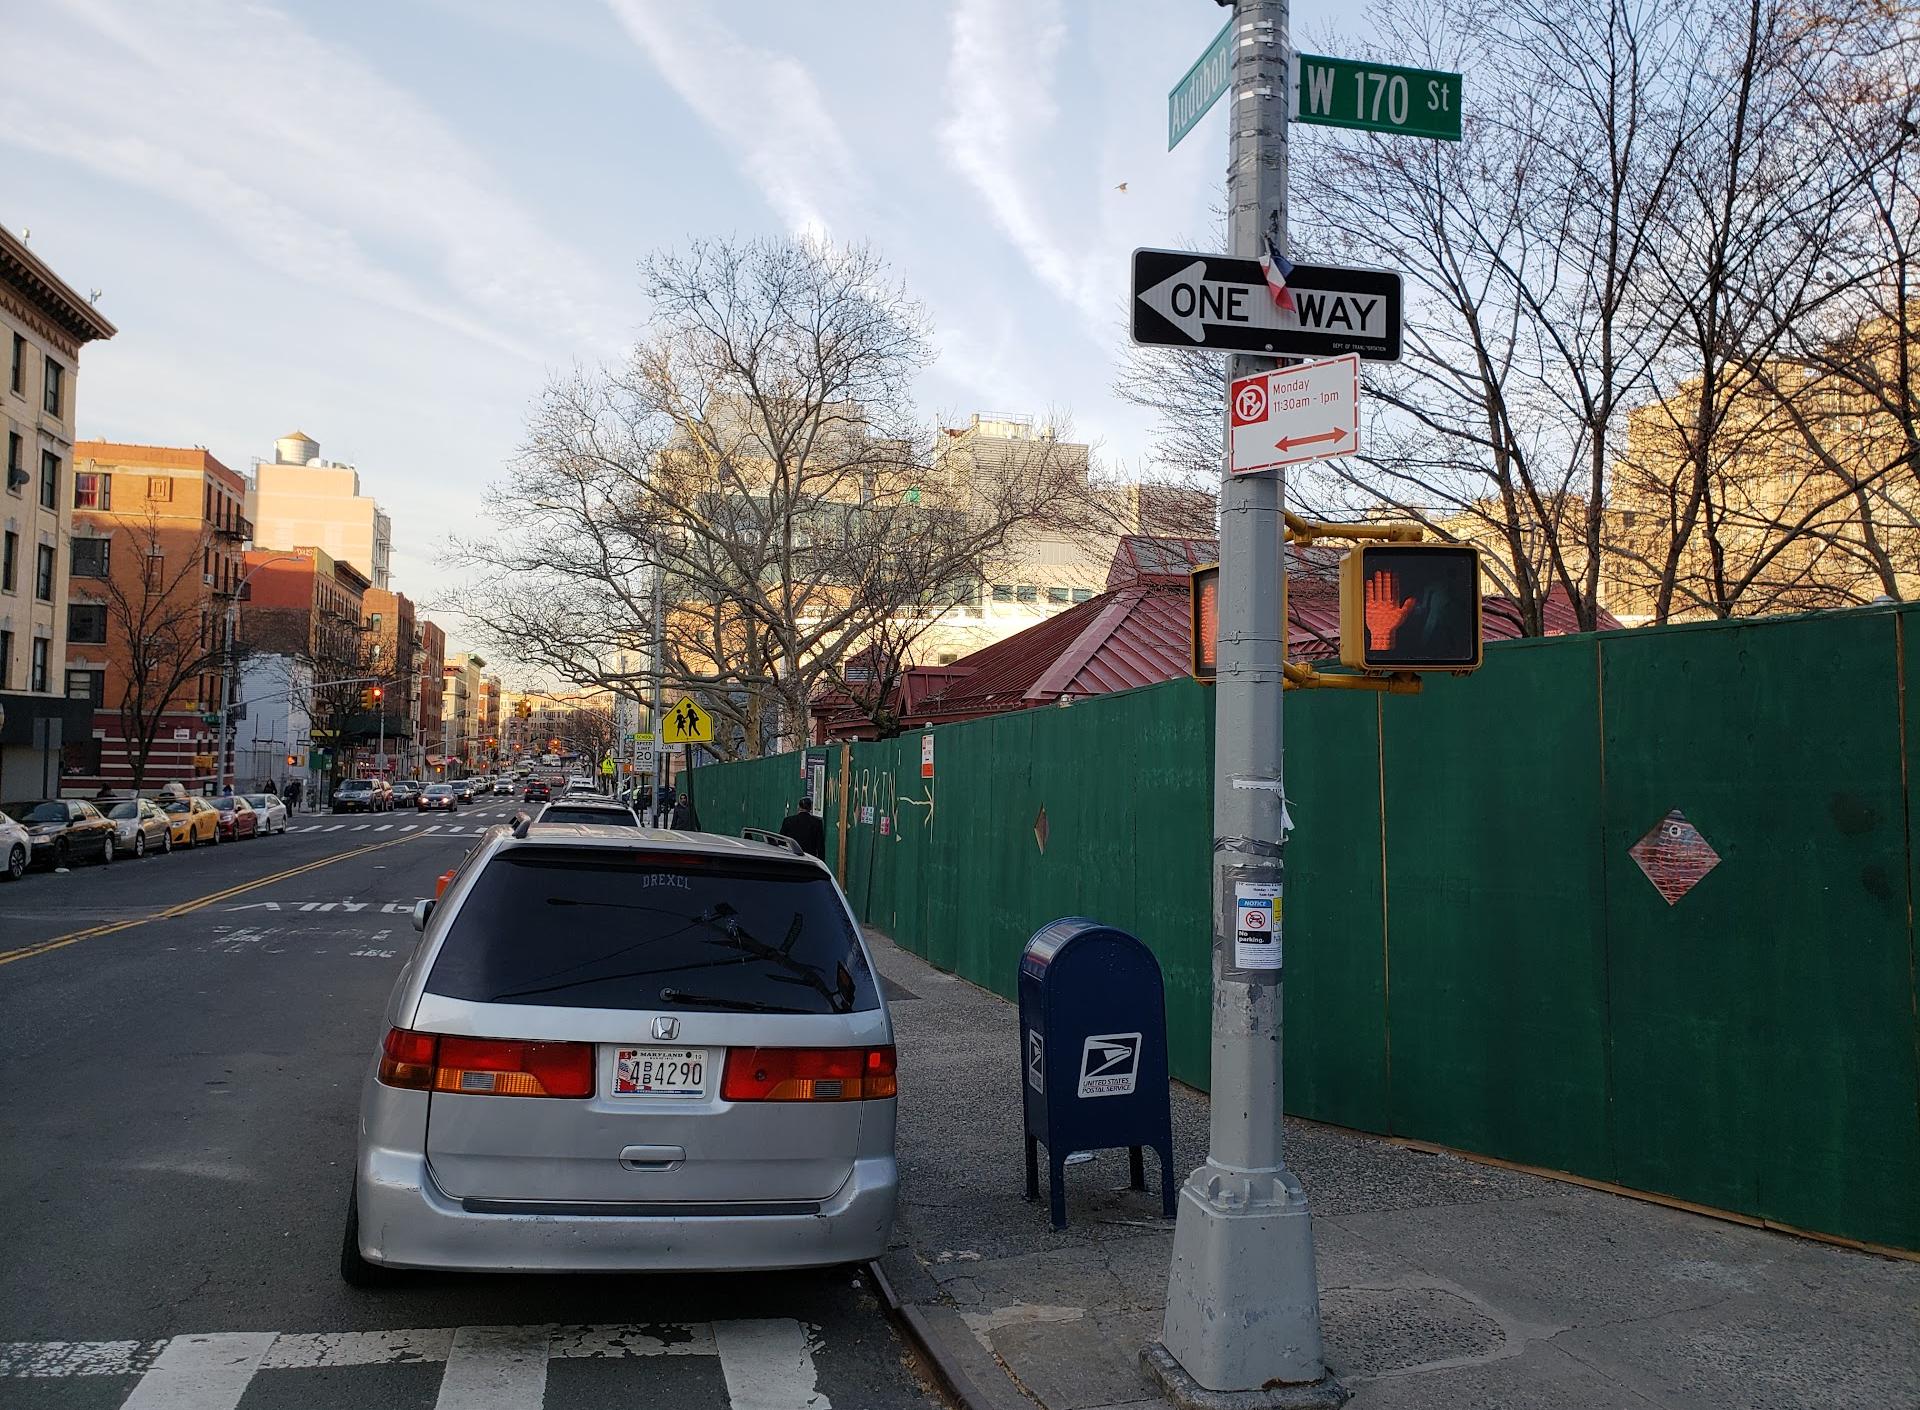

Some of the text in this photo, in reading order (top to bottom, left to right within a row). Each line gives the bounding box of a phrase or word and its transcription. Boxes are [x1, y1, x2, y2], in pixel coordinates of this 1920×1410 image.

[1171, 47, 1227, 138] Audubon
[1307, 65, 1450, 125] W 170 St
[1171, 282, 1378, 332] ONE WAY
[1273, 379, 1310, 395] Monday
[1273, 398, 1310, 413] 11:30am
[1320, 391, 1339, 405] 1pm
[636, 751, 652, 761] 20
[1083, 1077, 1129, 1087] UNITED STATES
[1106, 1084, 1131, 1092] SERVICE
